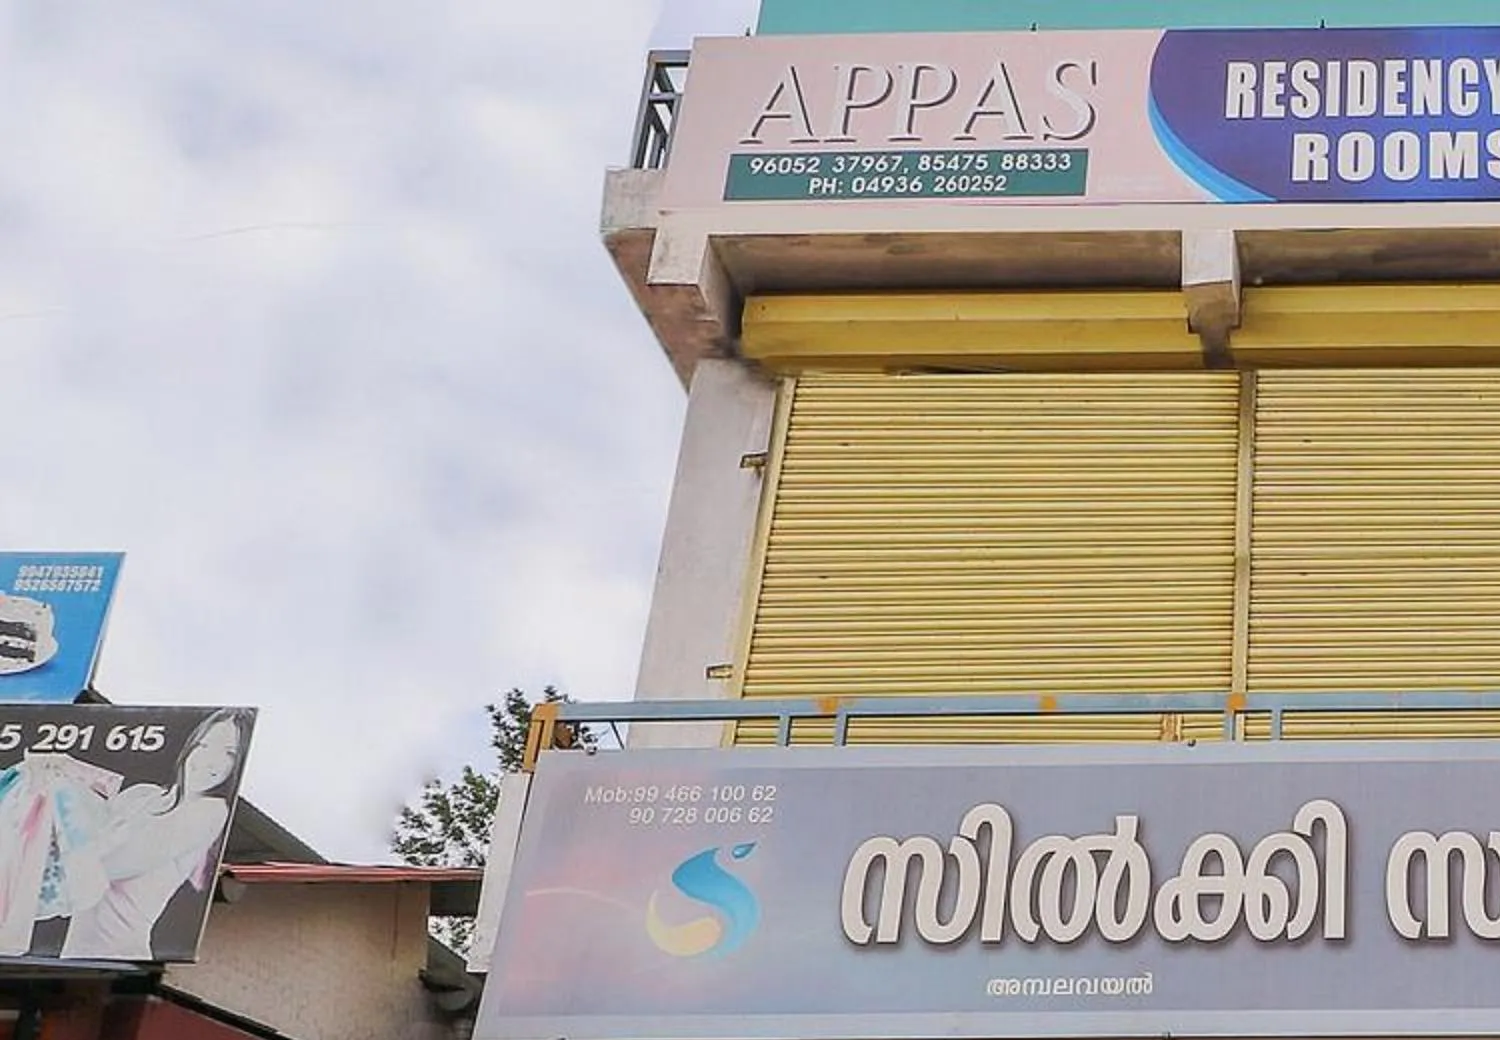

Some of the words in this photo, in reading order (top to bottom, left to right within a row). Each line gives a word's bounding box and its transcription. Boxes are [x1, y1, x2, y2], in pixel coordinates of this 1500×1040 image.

[739, 58, 1098, 145] APPAS
[750, 155, 820, 174] 96052
[832, 154, 909, 175] 37967,
[918, 154, 988, 171] 85475
[1001, 152, 1071, 170] 88333
[809, 177, 844, 194] PH:
[851, 175, 923, 193] 04936
[933, 175, 1008, 192] 260252
[31, 725, 95, 751] 291
[105, 725, 166, 751] 615
[664, 786, 703, 803] 466
[709, 786, 746, 803] 100
[752, 785, 777, 802] 62
[629, 807, 656, 824] 90
[662, 807, 698, 824] 728
[704, 807, 741, 823] 006
[747, 806, 773, 823] 62
[842, 802, 1352, 945] സിൽക്കി
